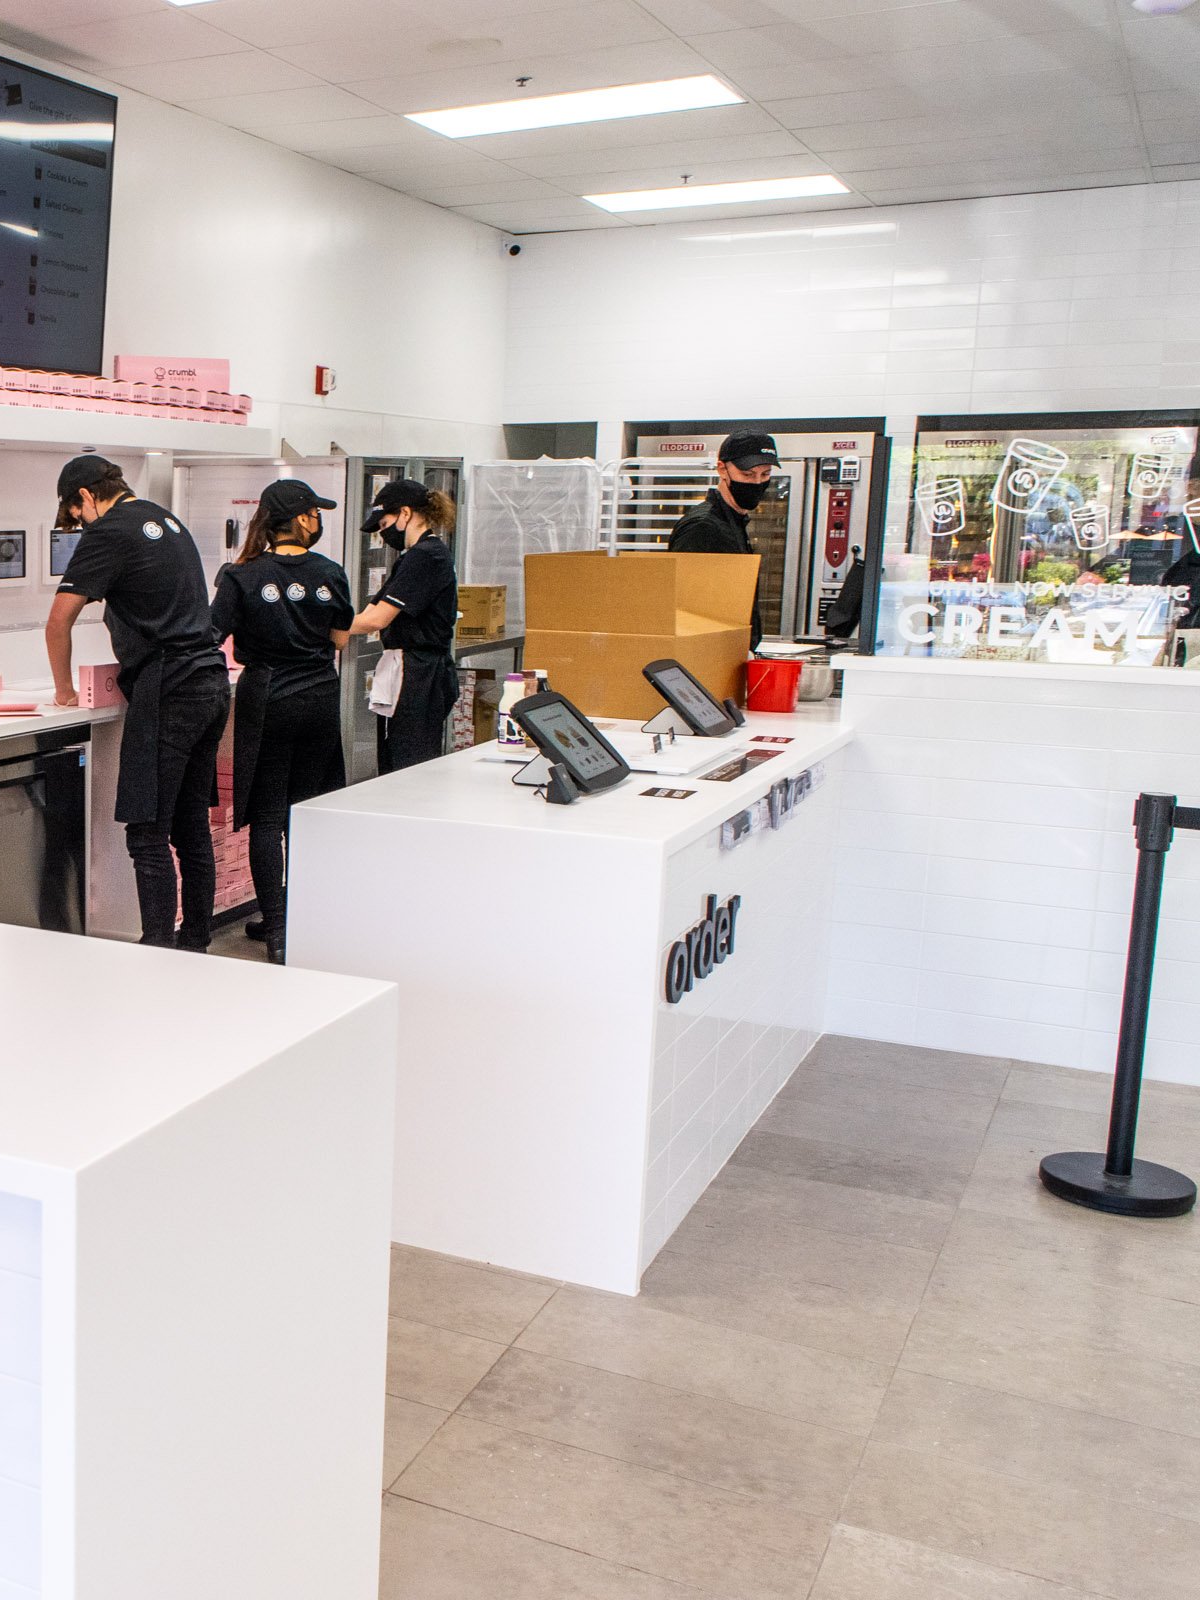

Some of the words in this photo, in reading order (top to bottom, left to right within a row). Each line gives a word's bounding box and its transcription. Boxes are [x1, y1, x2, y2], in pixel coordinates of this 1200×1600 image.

[167, 368, 197, 377] crumbl
[661, 443, 704, 451] BLODGETT
[835, 441, 857, 449] XCEL
[1013, 580, 1073, 598] NOW
[899, 603, 1139, 648] CREAM
[664, 893, 742, 1004] order
